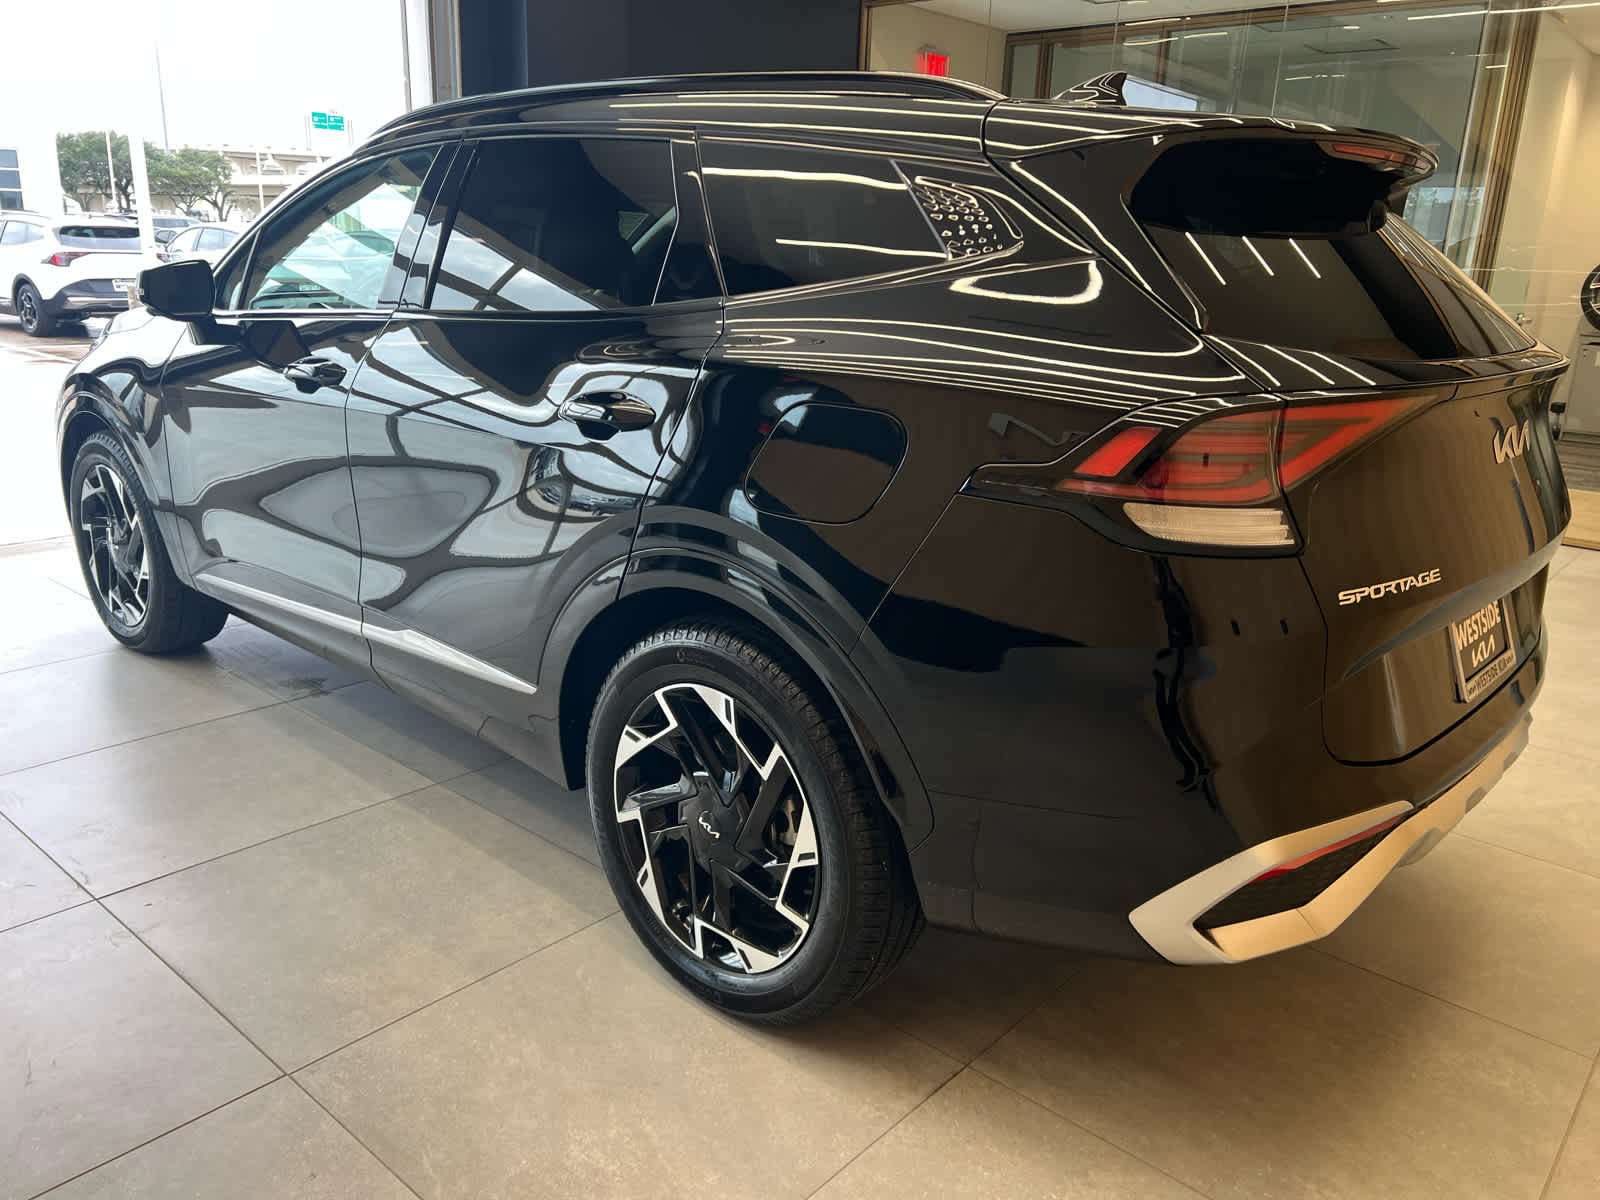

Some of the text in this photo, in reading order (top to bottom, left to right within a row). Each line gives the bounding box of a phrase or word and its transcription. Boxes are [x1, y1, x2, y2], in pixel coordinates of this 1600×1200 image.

[1492, 419, 1530, 464] KIA
[1338, 568, 1441, 605] SPORTAGE
[1456, 600, 1501, 651] WESTSIDE
[1471, 634, 1495, 668] KIA
